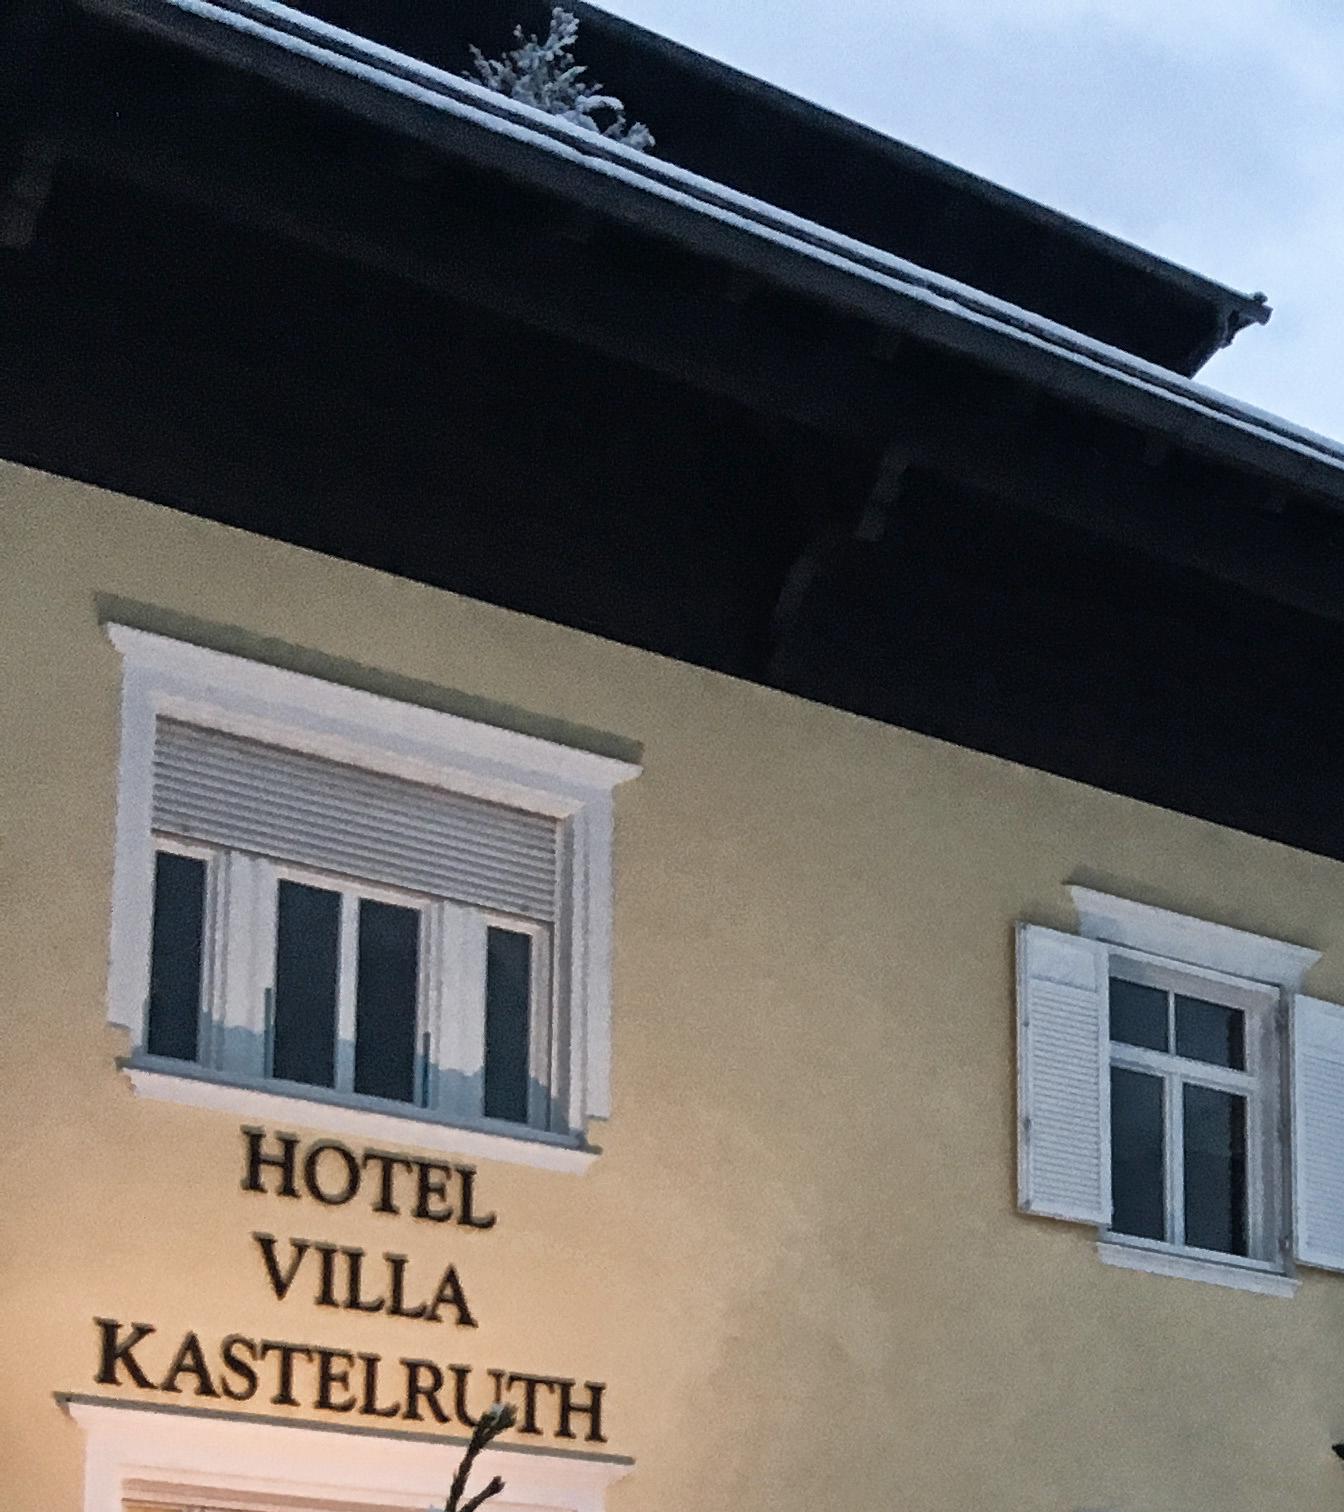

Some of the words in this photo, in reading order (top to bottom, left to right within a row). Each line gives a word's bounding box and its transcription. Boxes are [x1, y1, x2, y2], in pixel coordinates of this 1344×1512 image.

[240, 1124, 497, 1230] HOTEL
[252, 1231, 478, 1328] VILLA
[93, 1316, 608, 1443] KASTELRUTH
